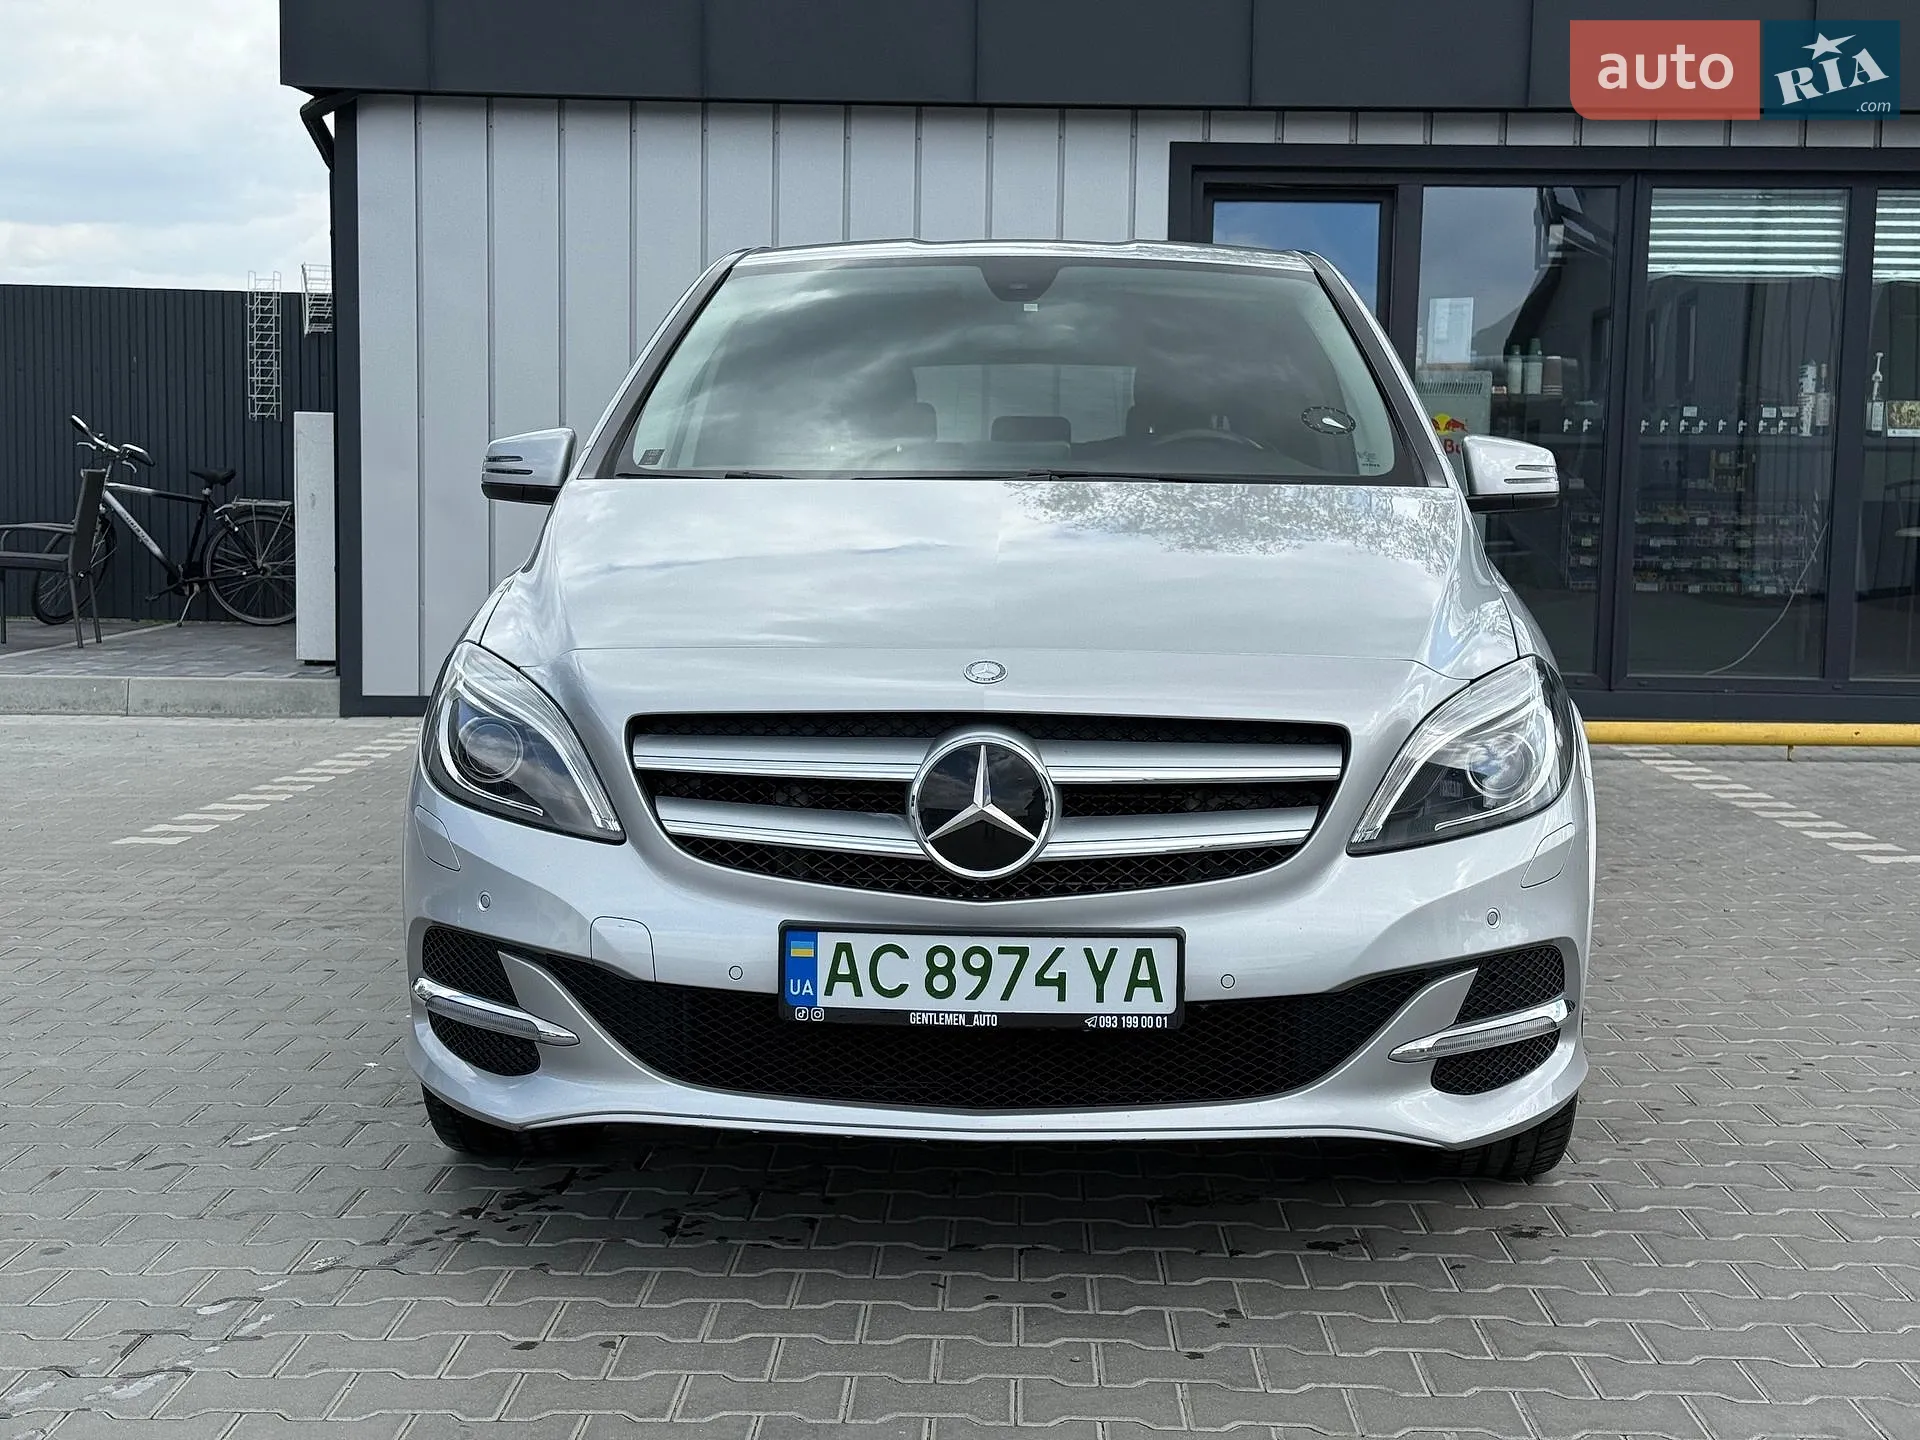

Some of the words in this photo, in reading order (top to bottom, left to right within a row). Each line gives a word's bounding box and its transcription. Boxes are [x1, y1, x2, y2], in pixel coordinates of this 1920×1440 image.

[823, 942, 910, 999] AC
[924, 944, 1067, 1002] 8974
[1083, 947, 1164, 1003] YA
[789, 978, 814, 996] UA
[909, 1012, 998, 1027] GENTLEMEN_AUTO
[1099, 1015, 1118, 1028] 093
[1121, 1015, 1139, 1028] 199
[1141, 1016, 1153, 1028] 00
[1155, 1016, 1167, 1028] 01
